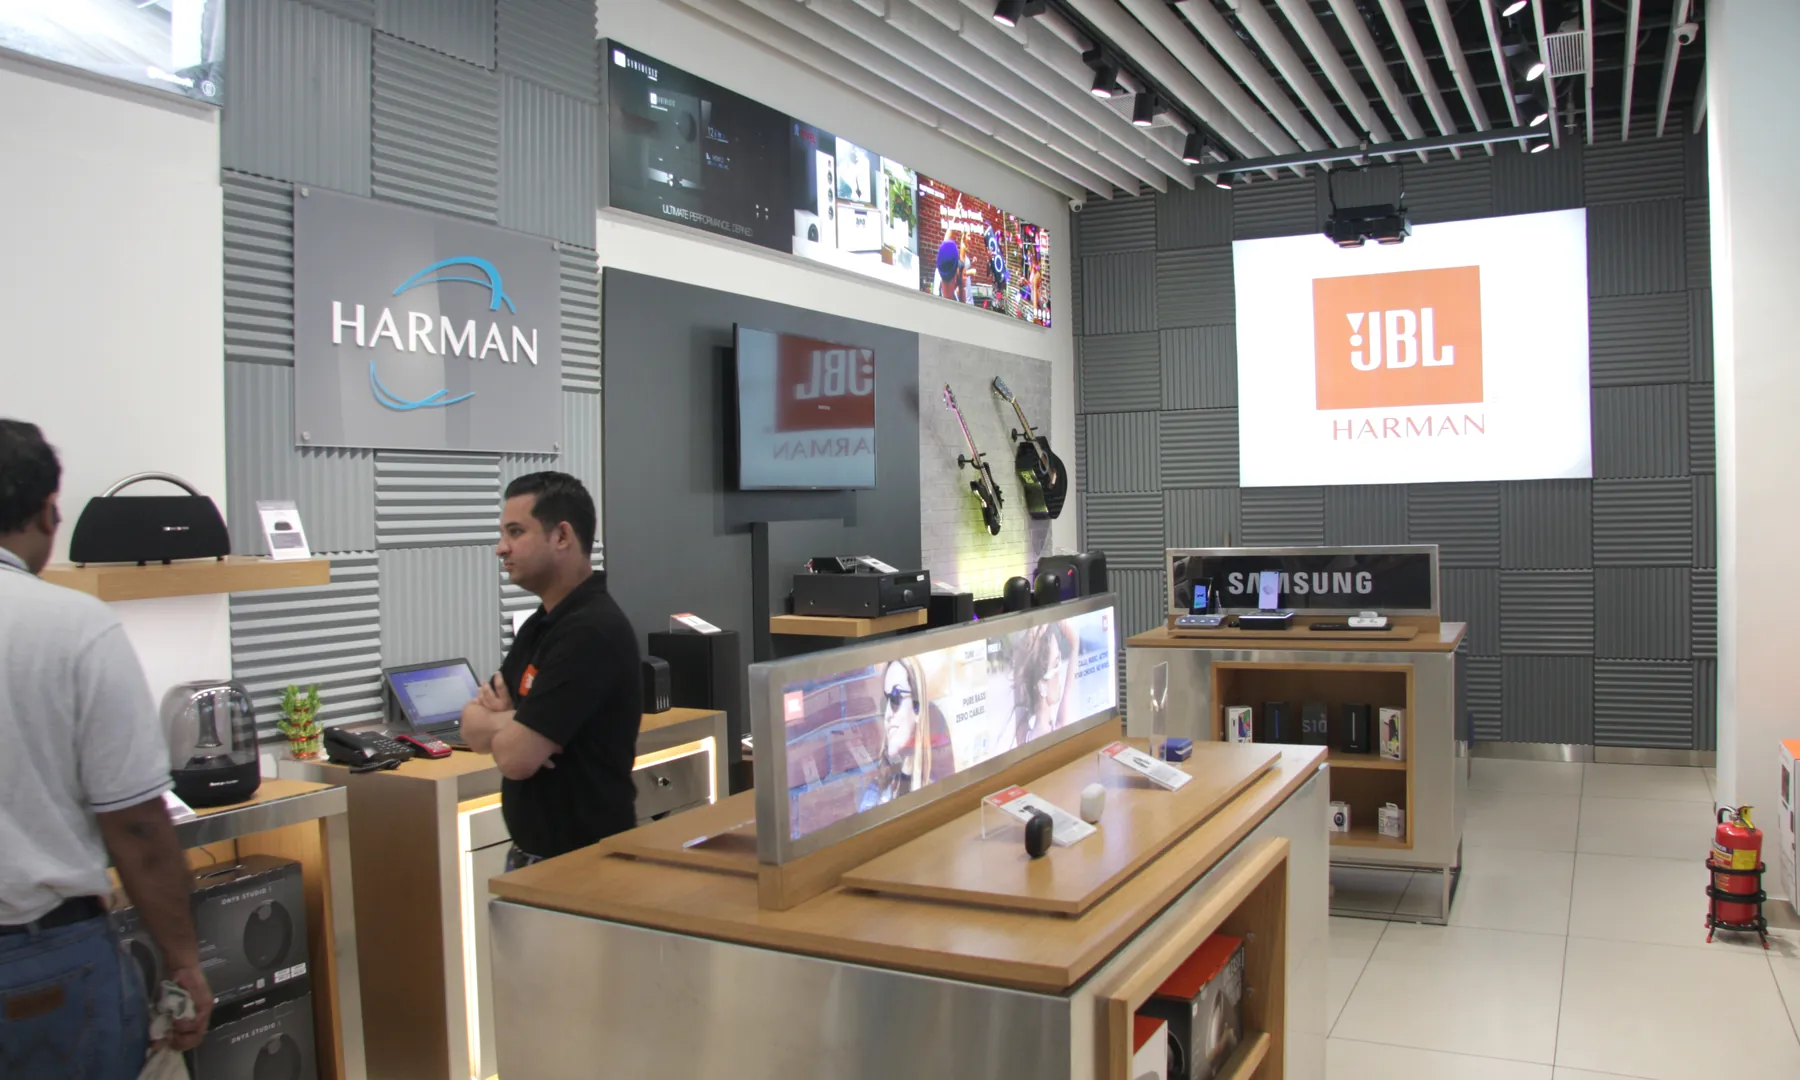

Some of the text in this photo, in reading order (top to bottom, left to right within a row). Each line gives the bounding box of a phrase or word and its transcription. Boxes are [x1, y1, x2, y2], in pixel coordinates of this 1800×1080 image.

[662, 203, 689, 220] ULTIMATE
[331, 300, 538, 366] HARMAN
[1346, 307, 1455, 372] JBL
[1333, 413, 1486, 441] HARMAN
[955, 711, 969, 723] ZERO
[1302, 719, 1328, 733] S10
[221, 895, 240, 906] ONYX
[241, 886, 267, 900] STUDIO
